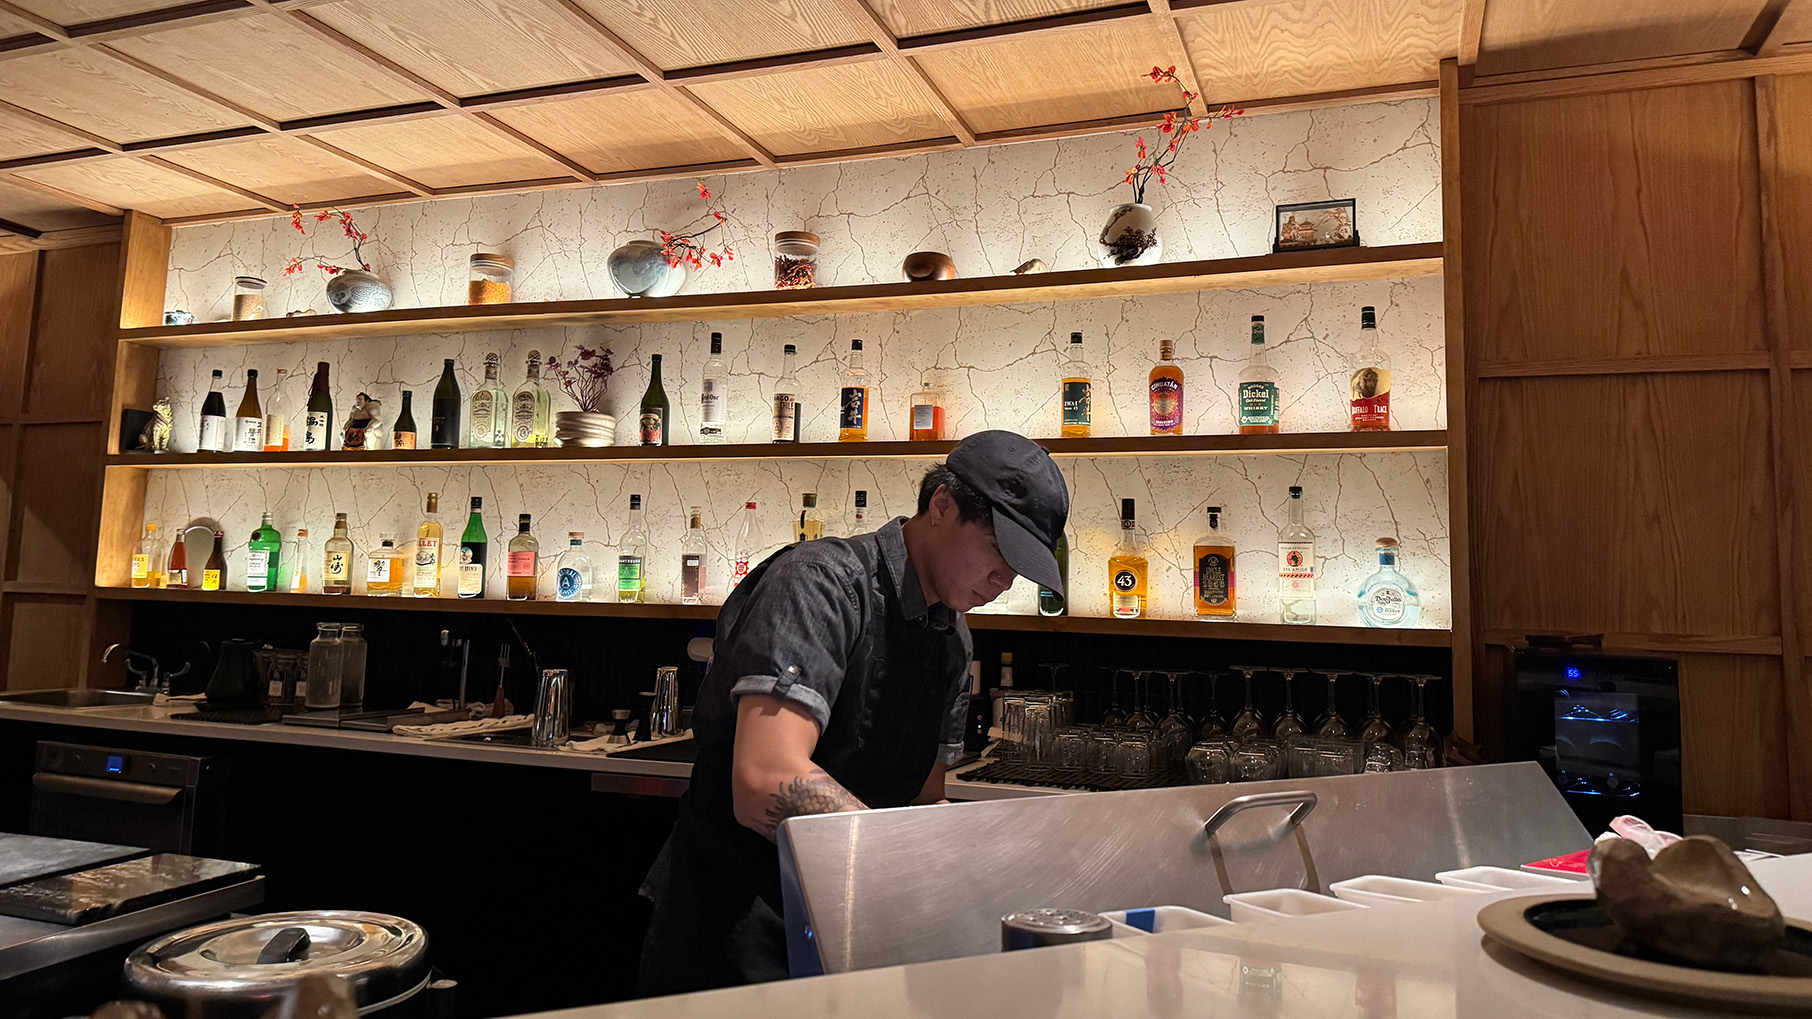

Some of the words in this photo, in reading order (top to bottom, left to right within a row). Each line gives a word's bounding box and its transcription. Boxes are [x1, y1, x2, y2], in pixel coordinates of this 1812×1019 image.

[1243, 389, 1269, 399] Dickel
[847, 389, 862, 425] 岩井
[330, 554, 344, 574] 山崎
[1117, 575, 1132, 586] 43
[1568, 669, 1578, 677] 55
